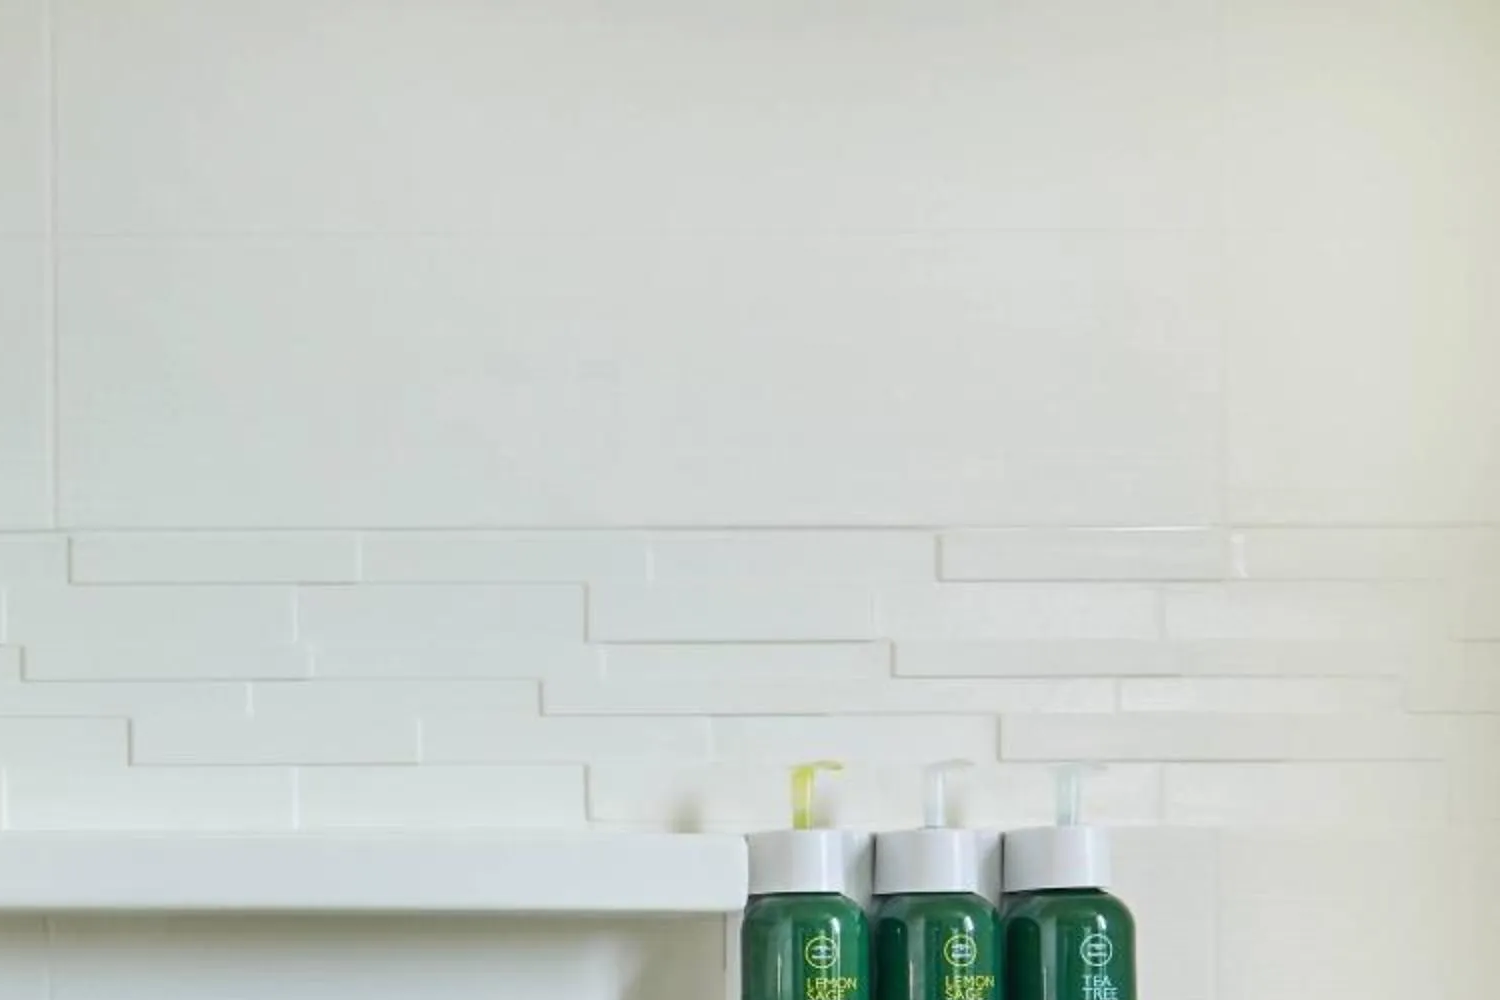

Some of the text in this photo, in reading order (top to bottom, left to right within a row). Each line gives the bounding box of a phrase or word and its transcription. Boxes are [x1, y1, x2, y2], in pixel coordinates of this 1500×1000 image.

[806, 977, 858, 990] LEMON
[945, 975, 995, 988] LEMON
[1082, 975, 1112, 987] TEA
[945, 988, 985, 1000] SAGE
[1082, 987, 1119, 1000] TREE
